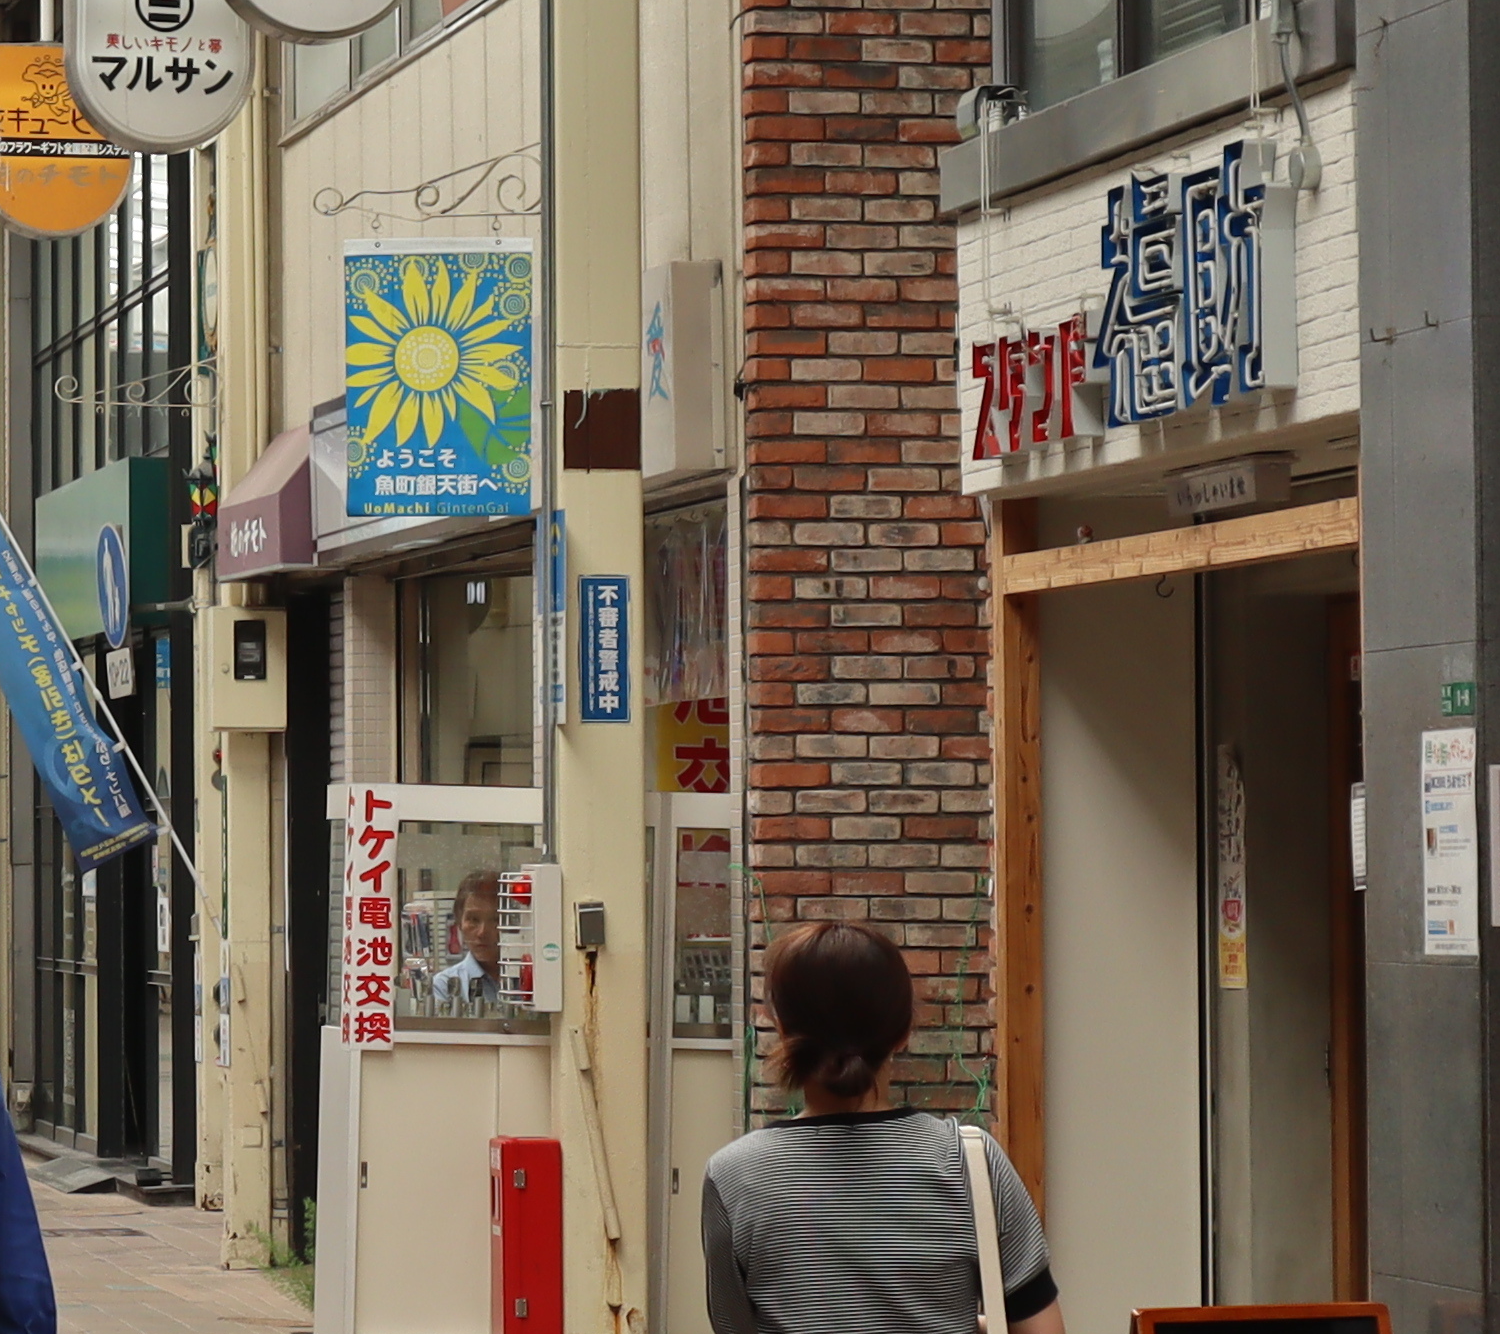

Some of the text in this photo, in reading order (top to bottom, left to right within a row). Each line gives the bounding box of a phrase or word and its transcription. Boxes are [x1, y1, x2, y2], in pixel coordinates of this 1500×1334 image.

[106, 32, 223, 55] 美しいキモノと帯
[91, 55, 234, 95] マルサン
[374, 447, 458, 469] ようこそ
[373, 472, 501, 498] 魚町銀天街へ
[363, 500, 511, 517] UoMachi GintenGai
[597, 584, 621, 714] 不審者警戒中
[353, 788, 396, 1045] トケイ電池交換
